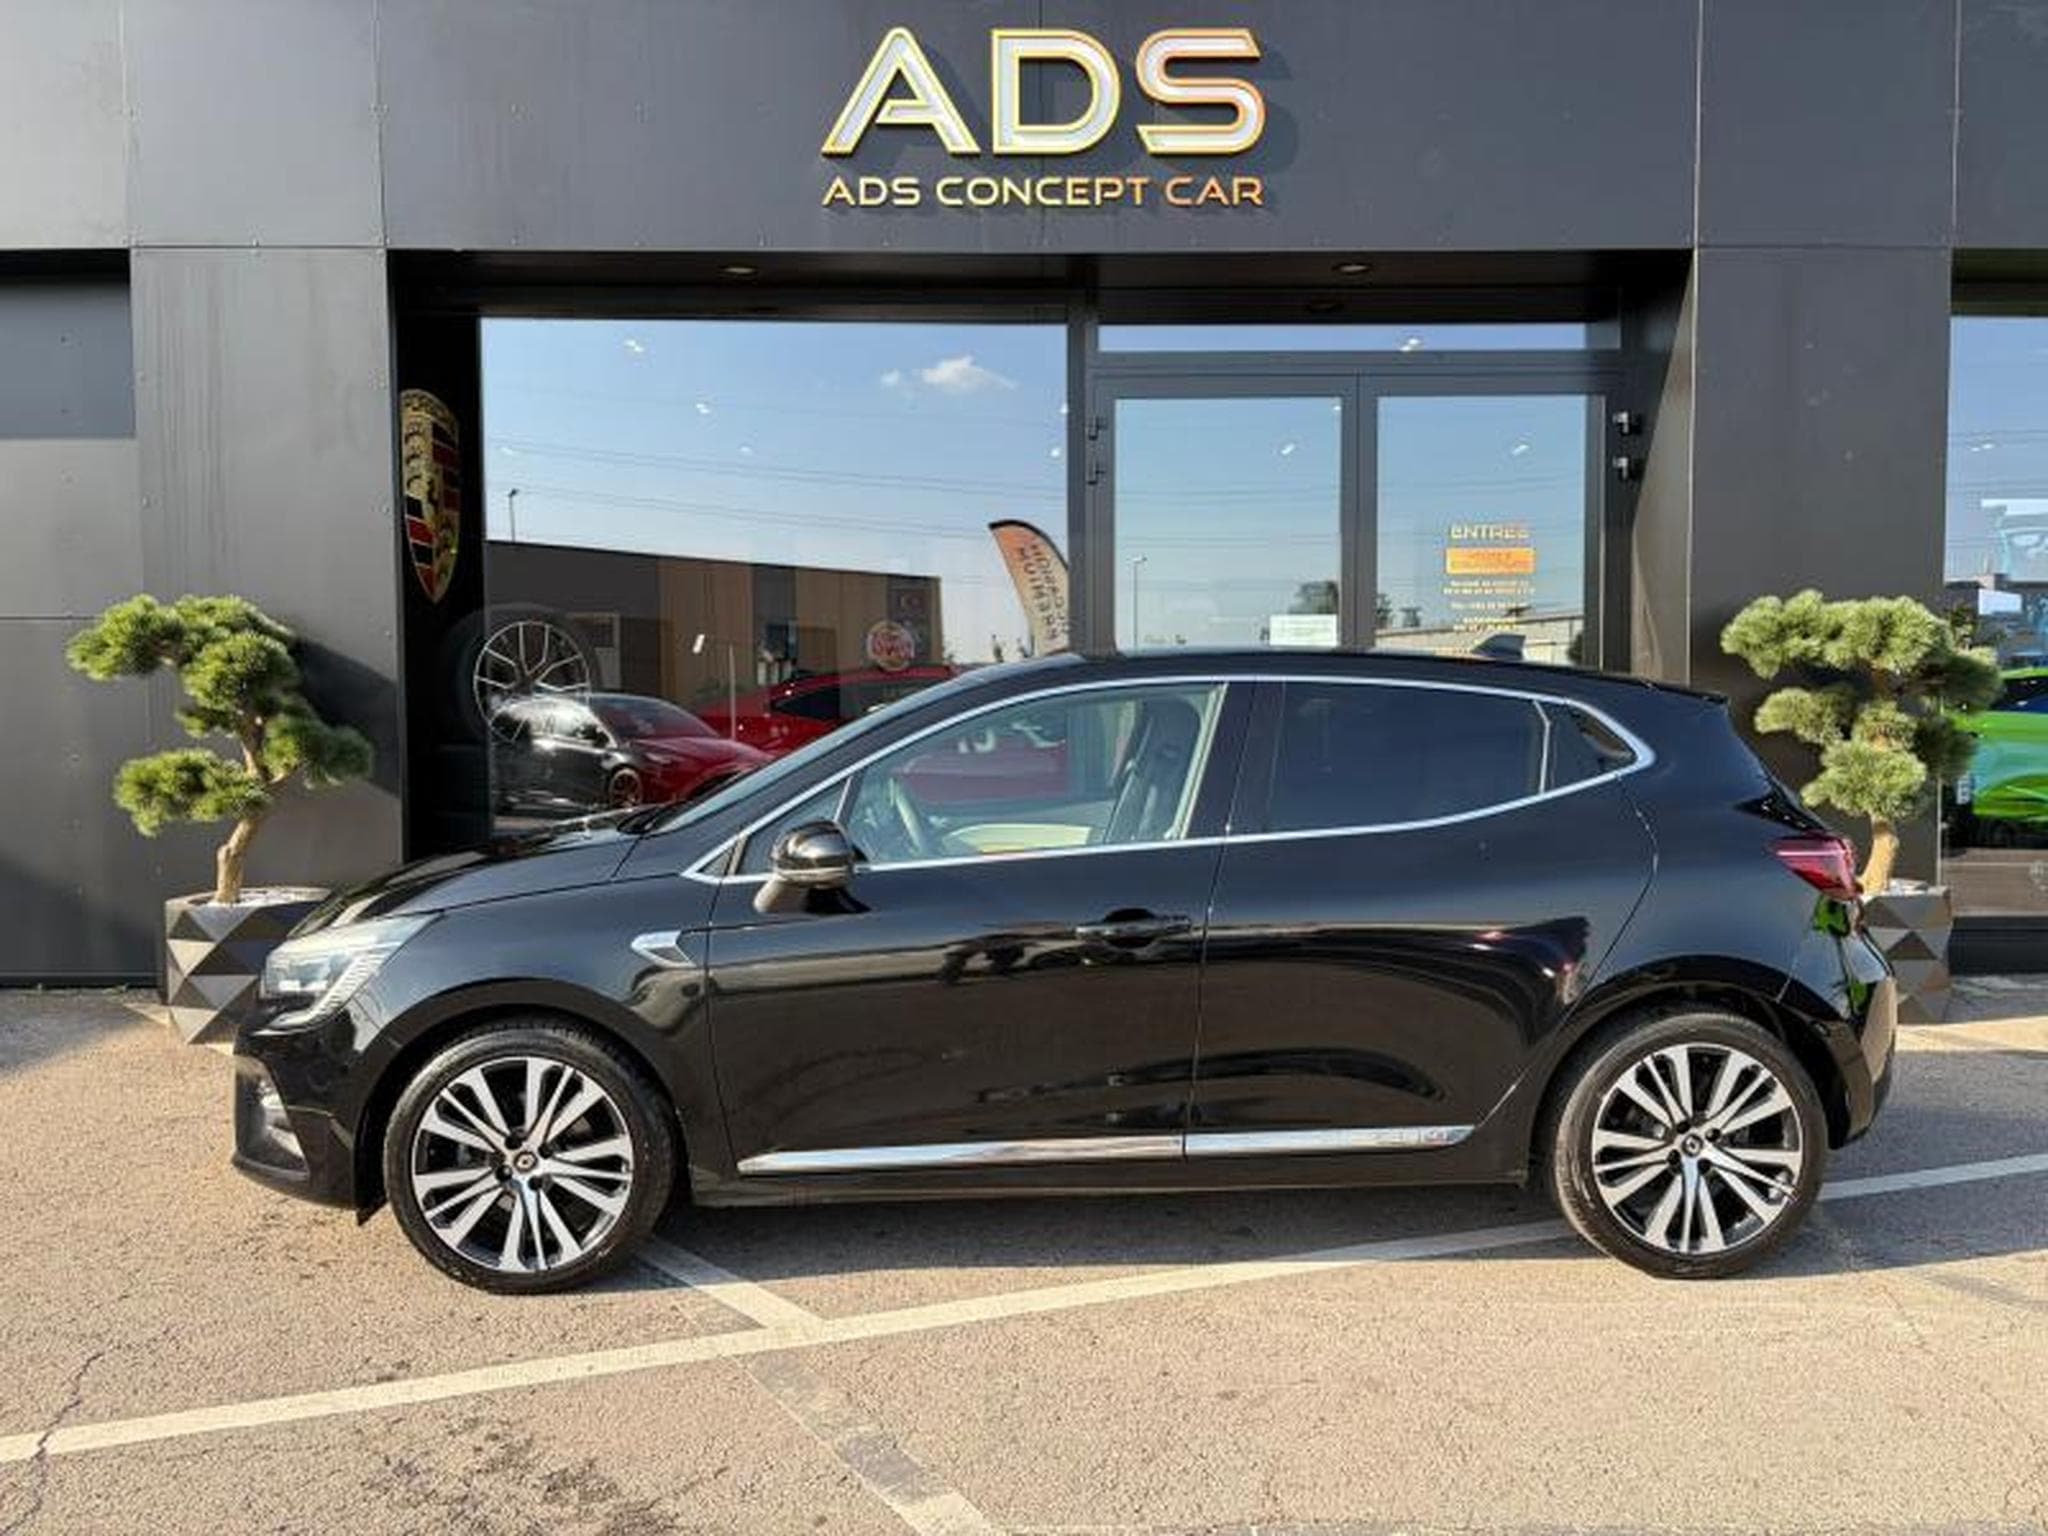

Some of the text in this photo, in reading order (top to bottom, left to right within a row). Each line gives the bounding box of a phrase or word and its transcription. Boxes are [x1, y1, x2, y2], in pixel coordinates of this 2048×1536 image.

[821, 27, 1266, 155] ADS
[822, 176, 1264, 206] ADS CONCEPT CAR
